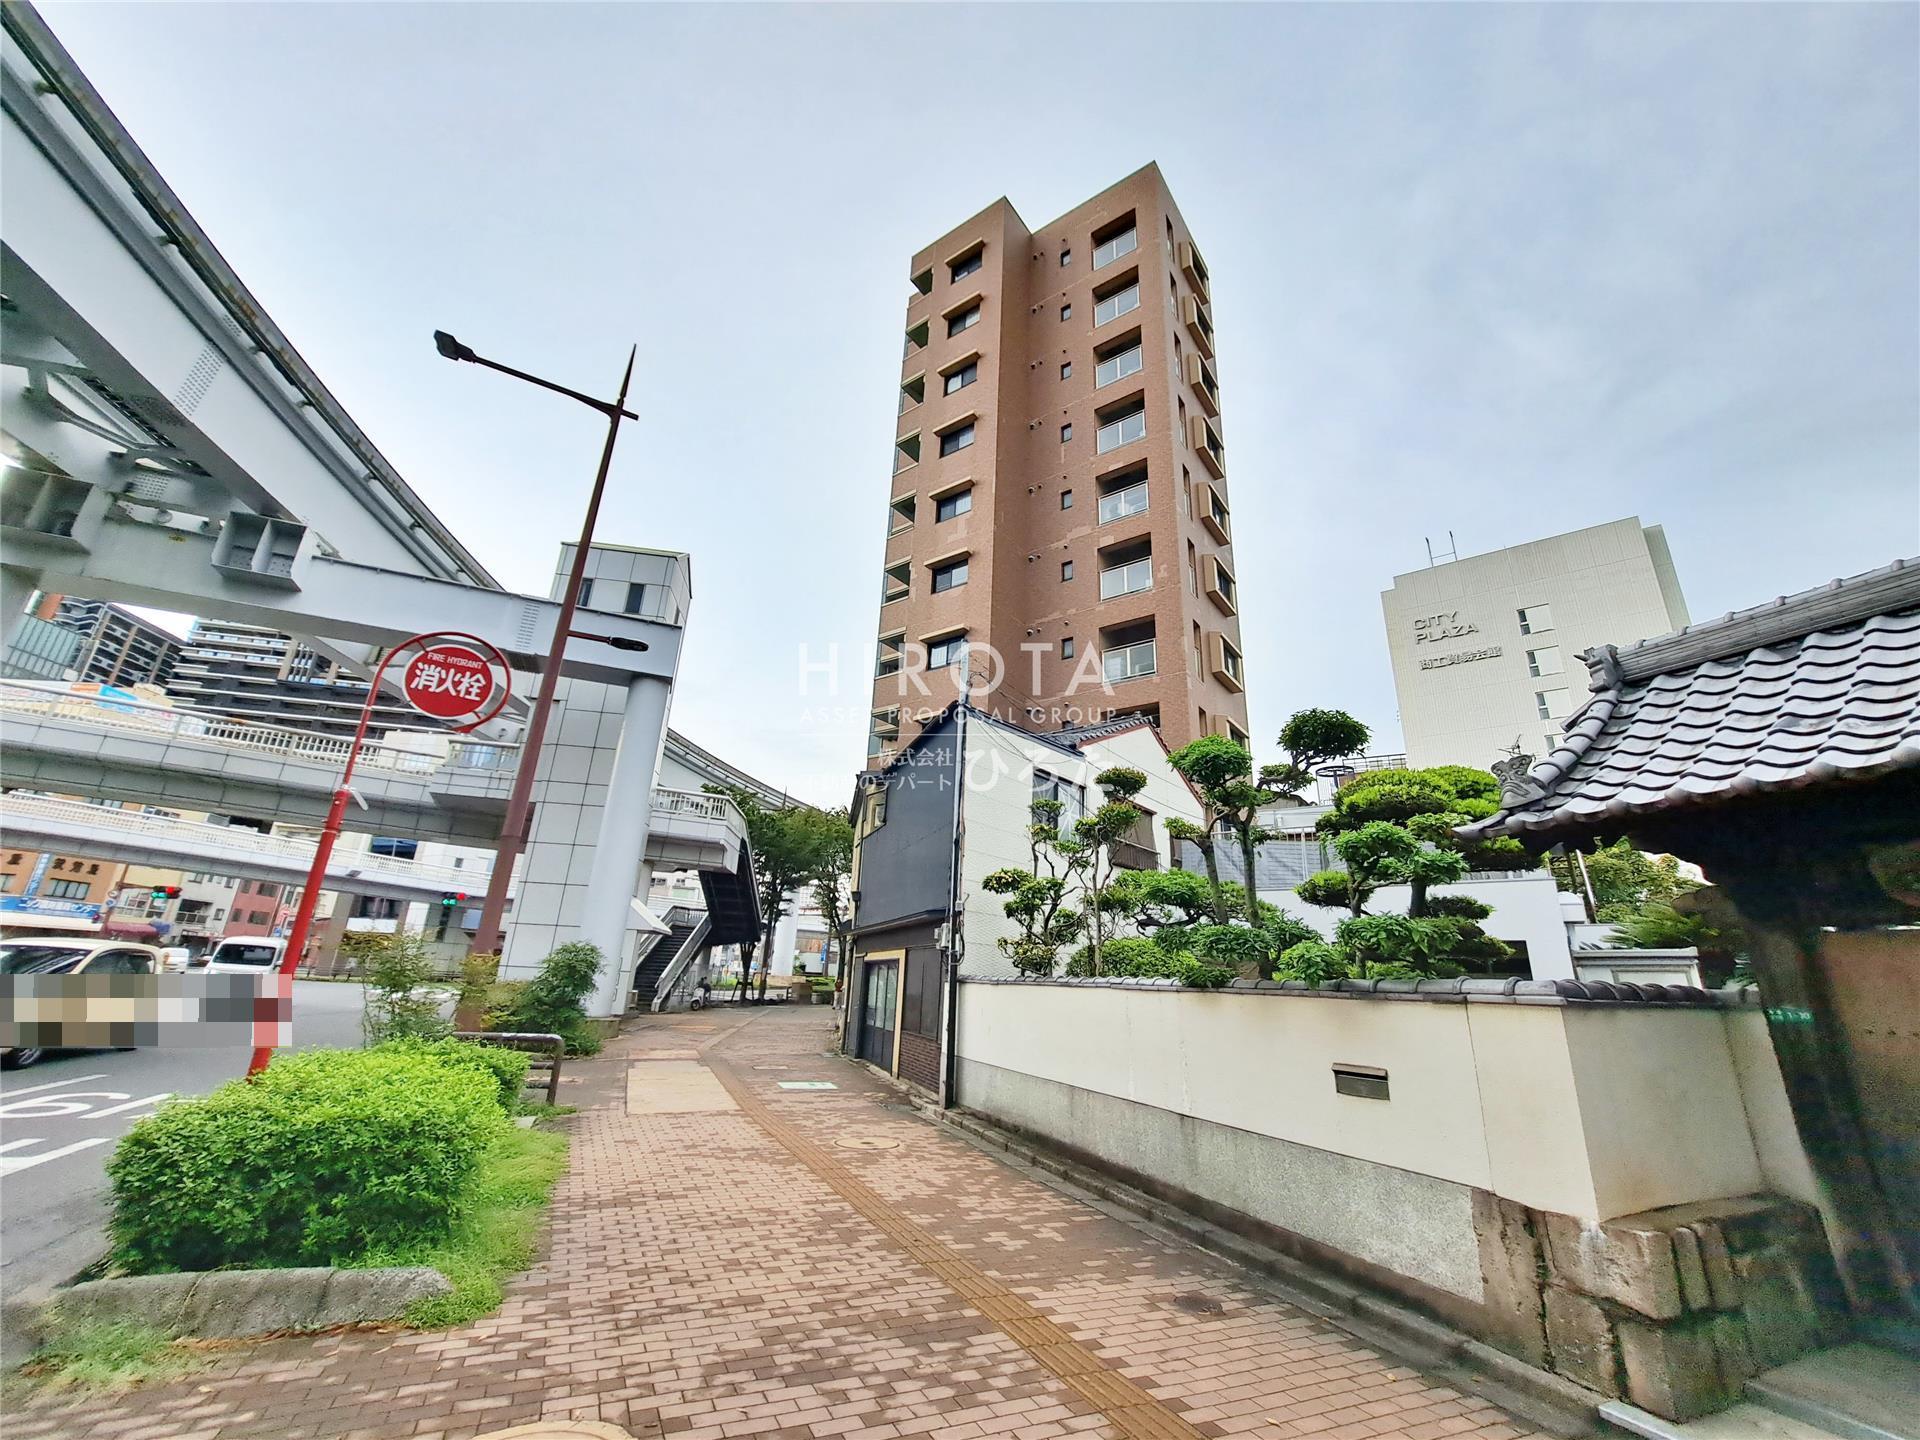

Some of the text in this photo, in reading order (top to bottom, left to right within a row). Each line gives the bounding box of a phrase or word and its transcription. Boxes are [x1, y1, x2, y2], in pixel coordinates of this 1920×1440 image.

[1414, 611, 1457, 630] CITY
[1415, 623, 1479, 645] PLAZA
[428, 652, 484, 669] FIRE HYDRANT
[411, 663, 486, 700] 消火栓
